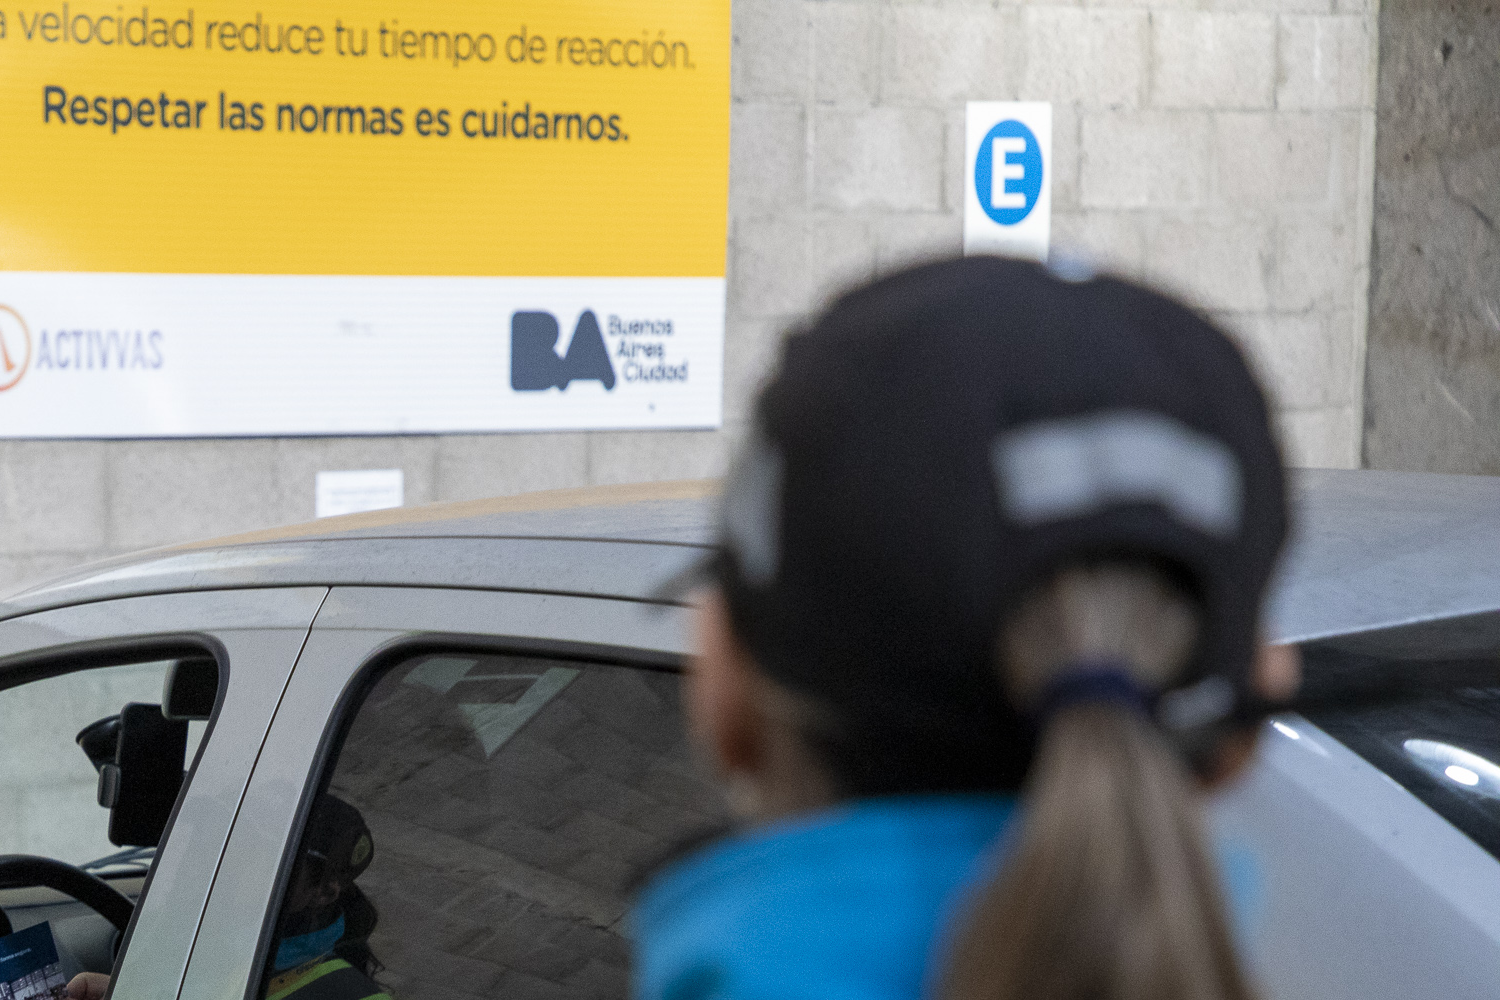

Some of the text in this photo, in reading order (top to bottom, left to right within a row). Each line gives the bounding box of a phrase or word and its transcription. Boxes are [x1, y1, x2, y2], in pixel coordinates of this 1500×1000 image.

[18, 1, 195, 49] velocidad
[205, 12, 325, 55] reduce
[335, 19, 368, 57] tu
[379, 19, 497, 68] tiempo
[505, 25, 547, 64] de
[556, 29, 696, 69] reacción.
[43, 85, 630, 141] Respetar las normas es cuidarnos.
[990, 136, 1027, 209] E
[510, 310, 616, 391] BA
[607, 314, 674, 336] Buenos
[618, 340, 665, 358] Aires
[624, 359, 689, 382] Ciudad
